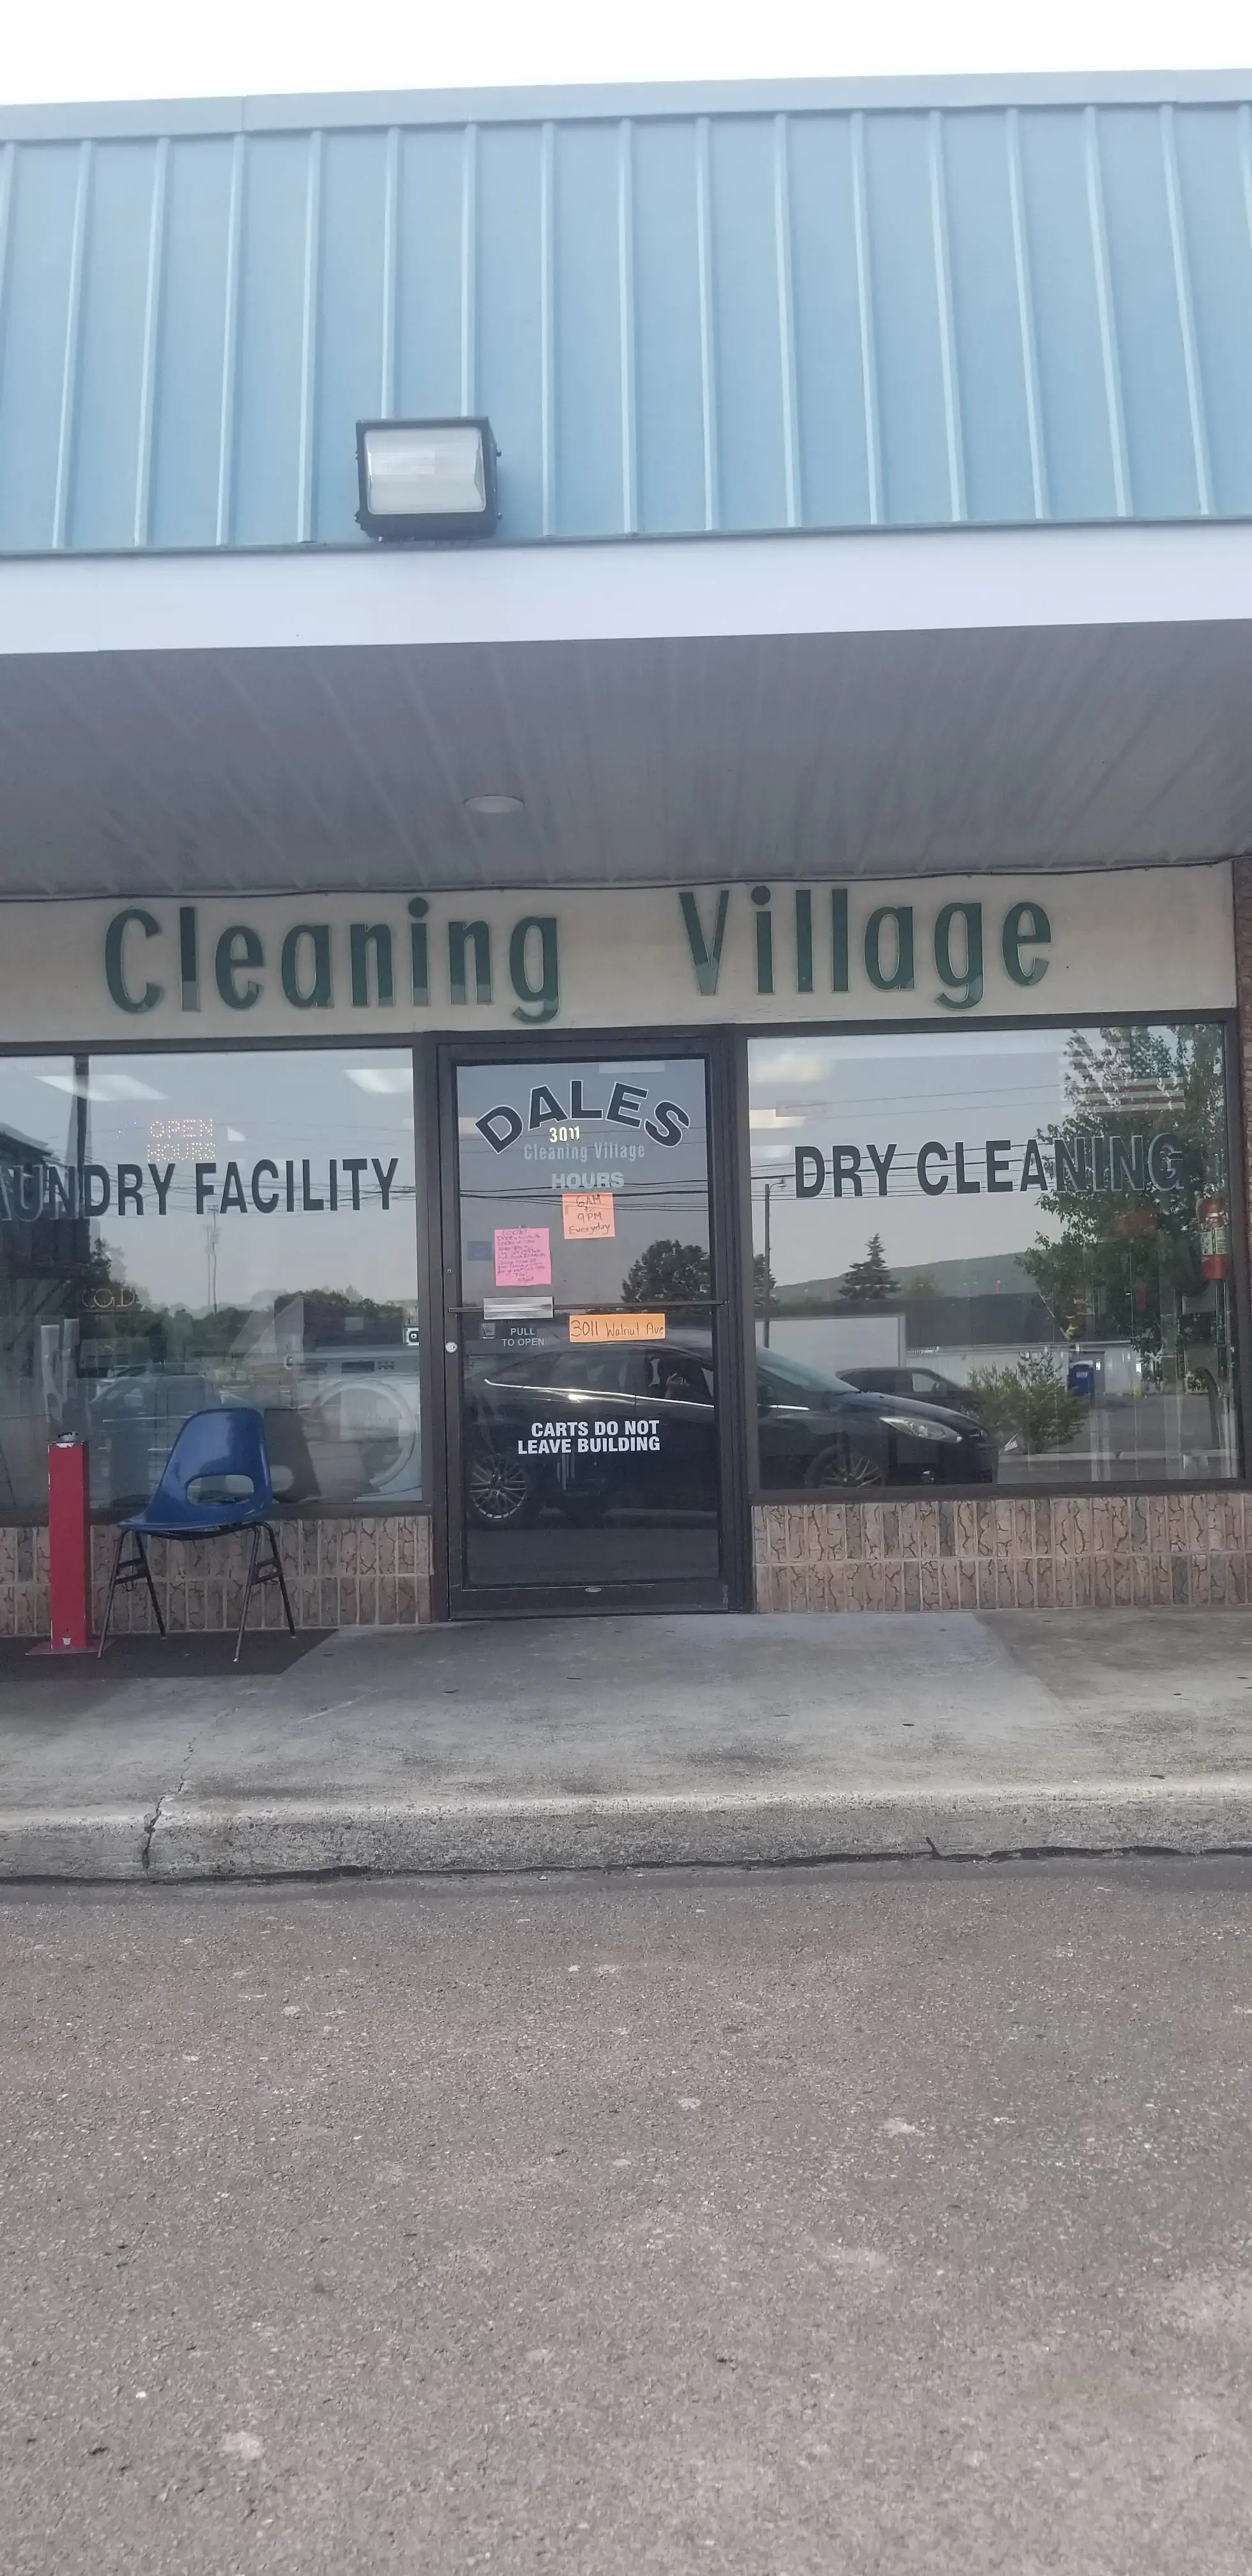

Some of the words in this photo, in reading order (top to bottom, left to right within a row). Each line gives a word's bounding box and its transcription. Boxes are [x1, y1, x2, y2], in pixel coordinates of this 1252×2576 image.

[104, 896, 559, 1023] Cleaning
[679, 885, 1053, 1009] Village
[475, 1080, 691, 1154] DALES
[150, 1119, 213, 1138] OPEN
[549, 1126, 580, 1143] 3011
[148, 1142, 216, 1162] HOURS
[524, 1142, 588, 1162] Cleaning
[594, 1141, 645, 1162] Village
[793, 1143, 897, 1199] DRY
[917, 1133, 1184, 1197] CLEANING
[195, 1157, 399, 1215] FACILITY
[551, 1171, 625, 1189] HOURS
[569, 1222, 610, 1234] Everyday
[571, 1320, 599, 1337] 3011
[606, 1322, 639, 1337] Walnut
[646, 1322, 664, 1334] Ave
[501, 1338, 515, 1347] TO
[517, 1338, 544, 1346] OPEN
[531, 1422, 588, 1438] CARTS
[595, 1420, 620, 1436] DO
[625, 1420, 660, 1436] NOT
[517, 1439, 572, 1455] LEAVE
[577, 1436, 660, 1453] BUILDING
